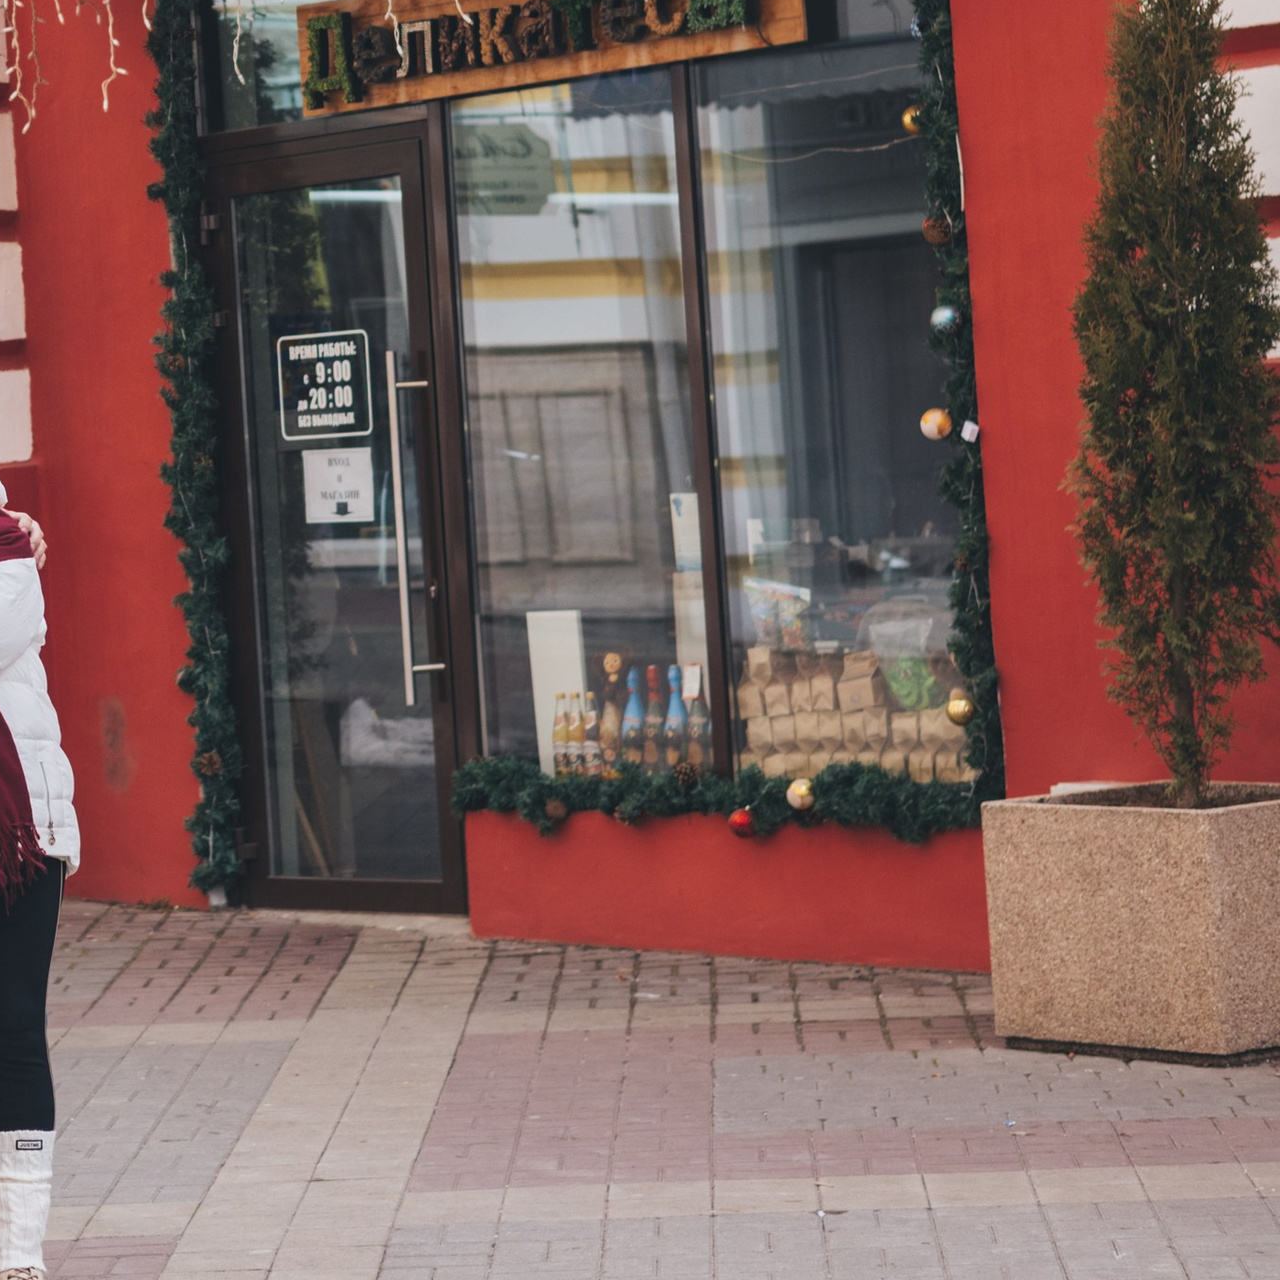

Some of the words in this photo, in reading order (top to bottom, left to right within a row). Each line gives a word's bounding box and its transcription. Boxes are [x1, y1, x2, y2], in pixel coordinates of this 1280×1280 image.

[288, 344, 318, 361] ВРЕМЯ
[318, 341, 357, 358] РАБОТЫ:
[315, 359, 351, 384] 9:00
[297, 399, 308, 412] до
[309, 385, 353, 410] 20:00
[327, 457, 351, 468] ВХОД
